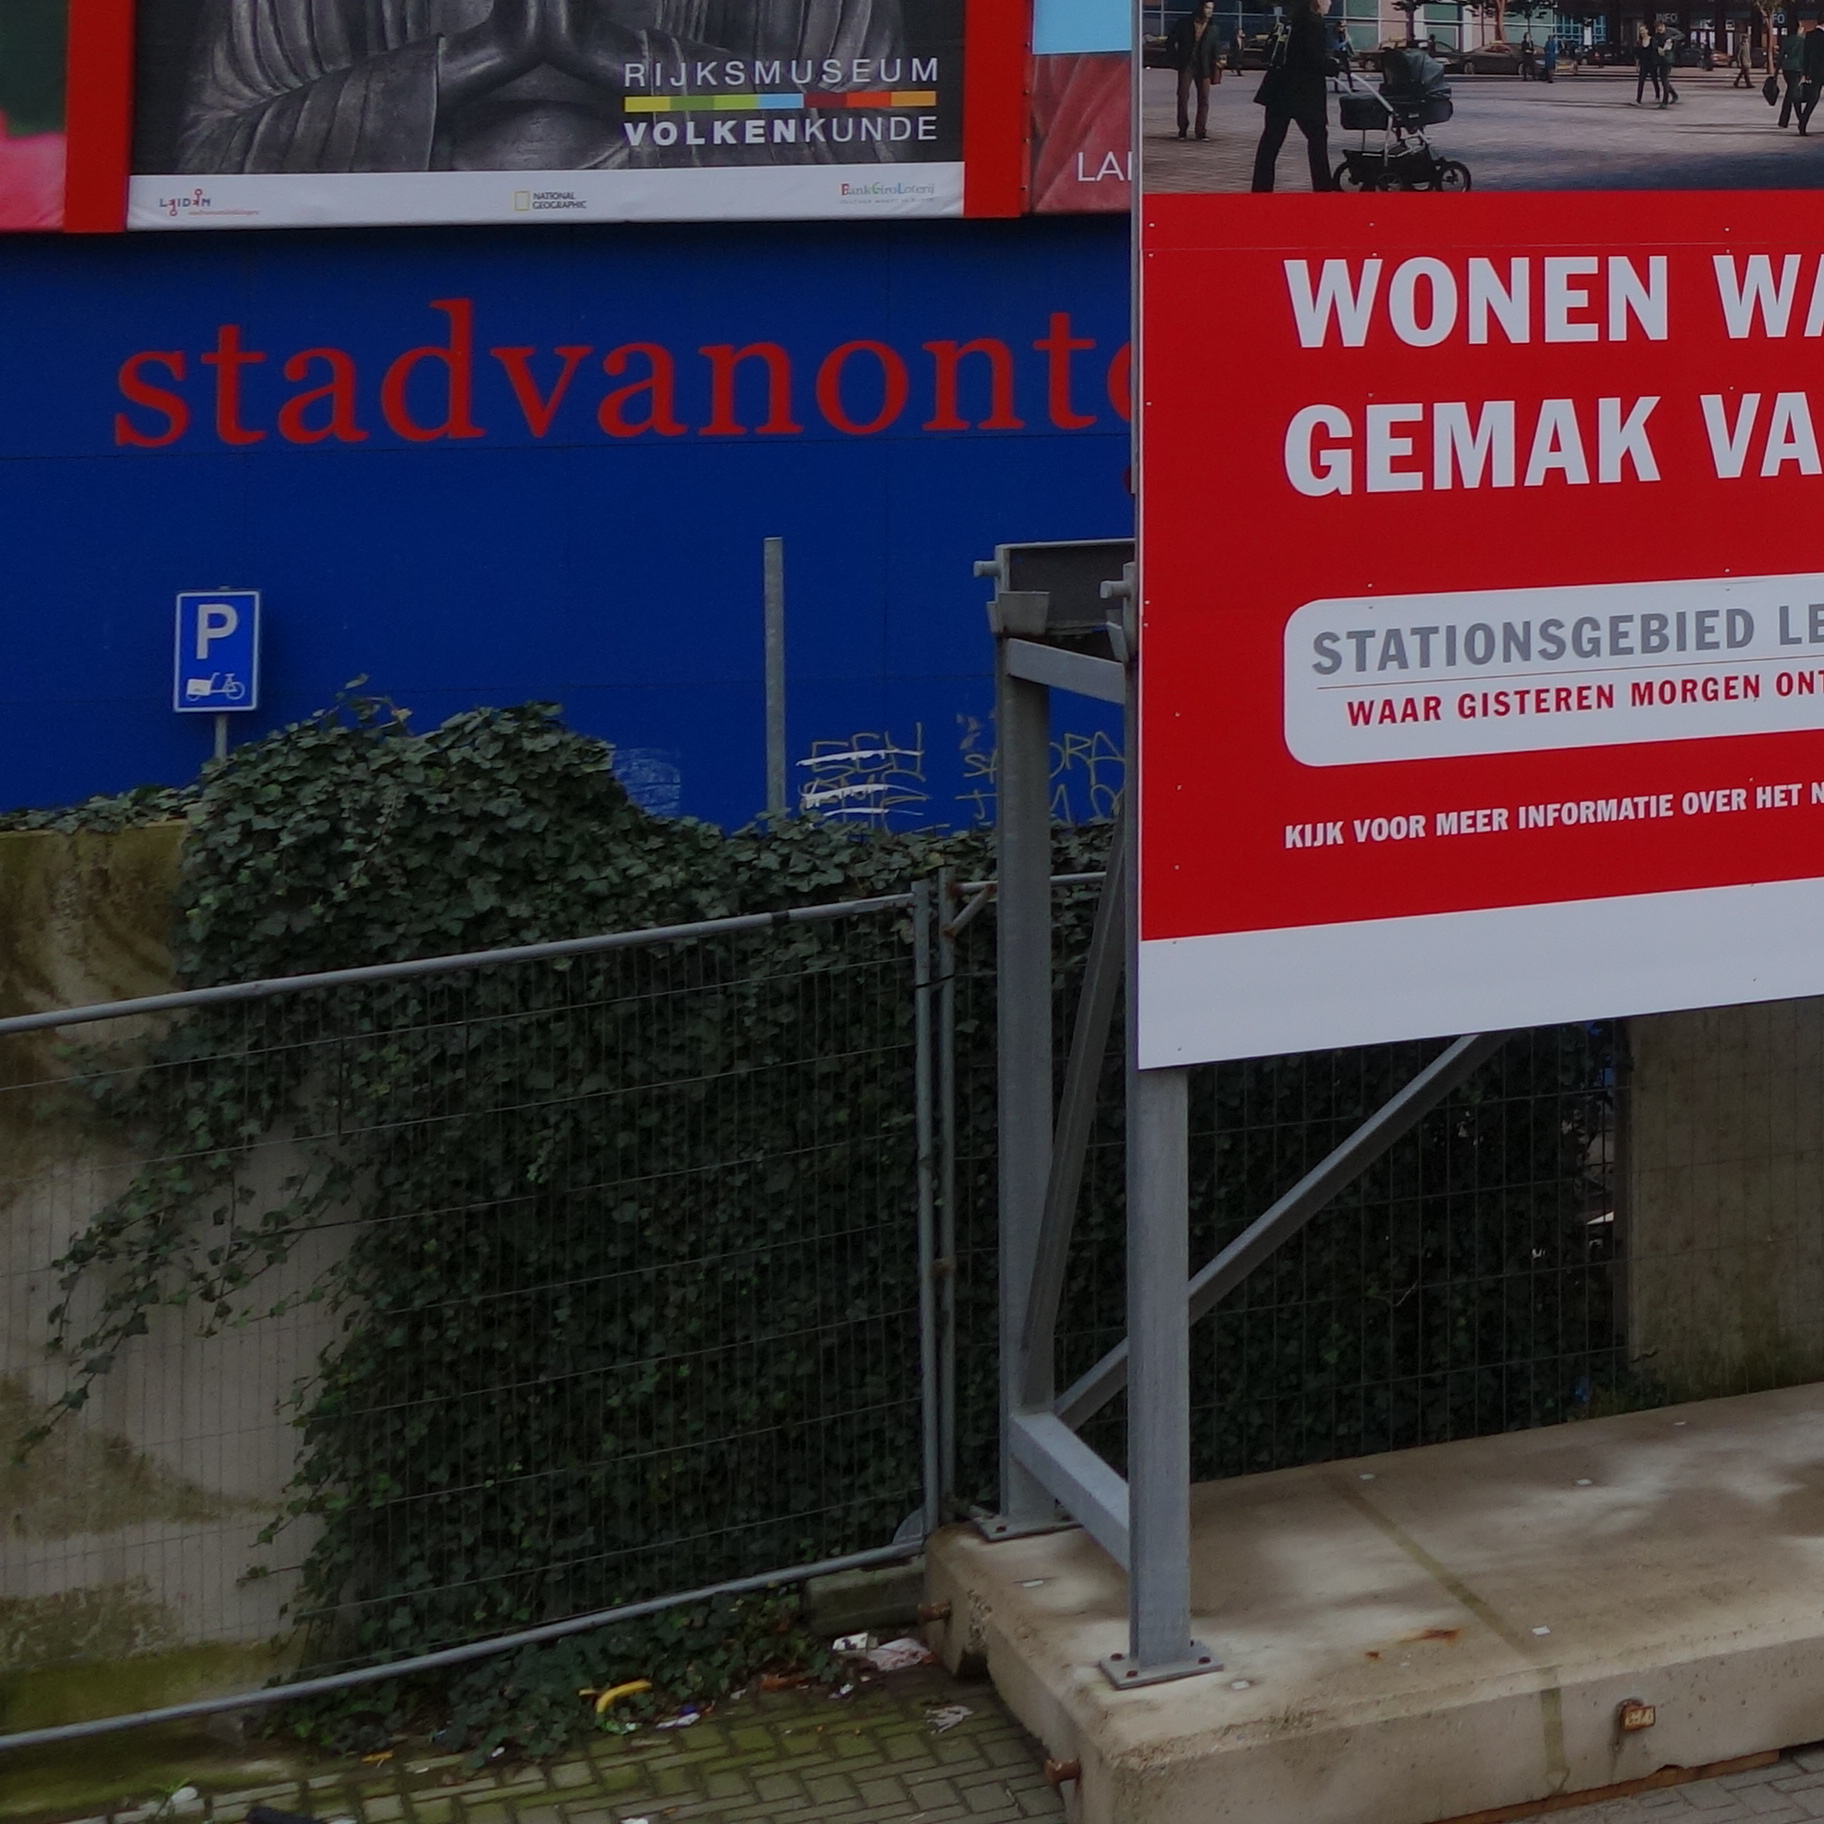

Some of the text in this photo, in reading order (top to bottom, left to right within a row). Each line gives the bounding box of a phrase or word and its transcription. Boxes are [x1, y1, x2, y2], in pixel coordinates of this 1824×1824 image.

[624, 58, 938, 87] RIJKSMUSEUM
[624, 116, 938, 146] VOLKENKUNDE
[1077, 150, 1132, 182] LA
[532, 201, 587, 209] GEOGRAPHIC
[533, 192, 576, 200] NATIONAL
[1284, 255, 1669, 348] WONEN
[1283, 396, 1661, 496] GEMAK
[197, 604, 238, 660] P
[1311, 607, 1755, 676] STATIONSGEBIED
[1347, 693, 1443, 728] WAAR
[1457, 684, 1616, 721] GISTEREN
[1630, 673, 1761, 707] MORGEN
[1284, 822, 1344, 849] KIJK
[1354, 813, 1426, 844] VOOR
[1436, 808, 1509, 836] MEER
[1518, 793, 1674, 829] INFORMATIE
[1681, 787, 1747, 815] OVER
[1756, 783, 1802, 809] HET
